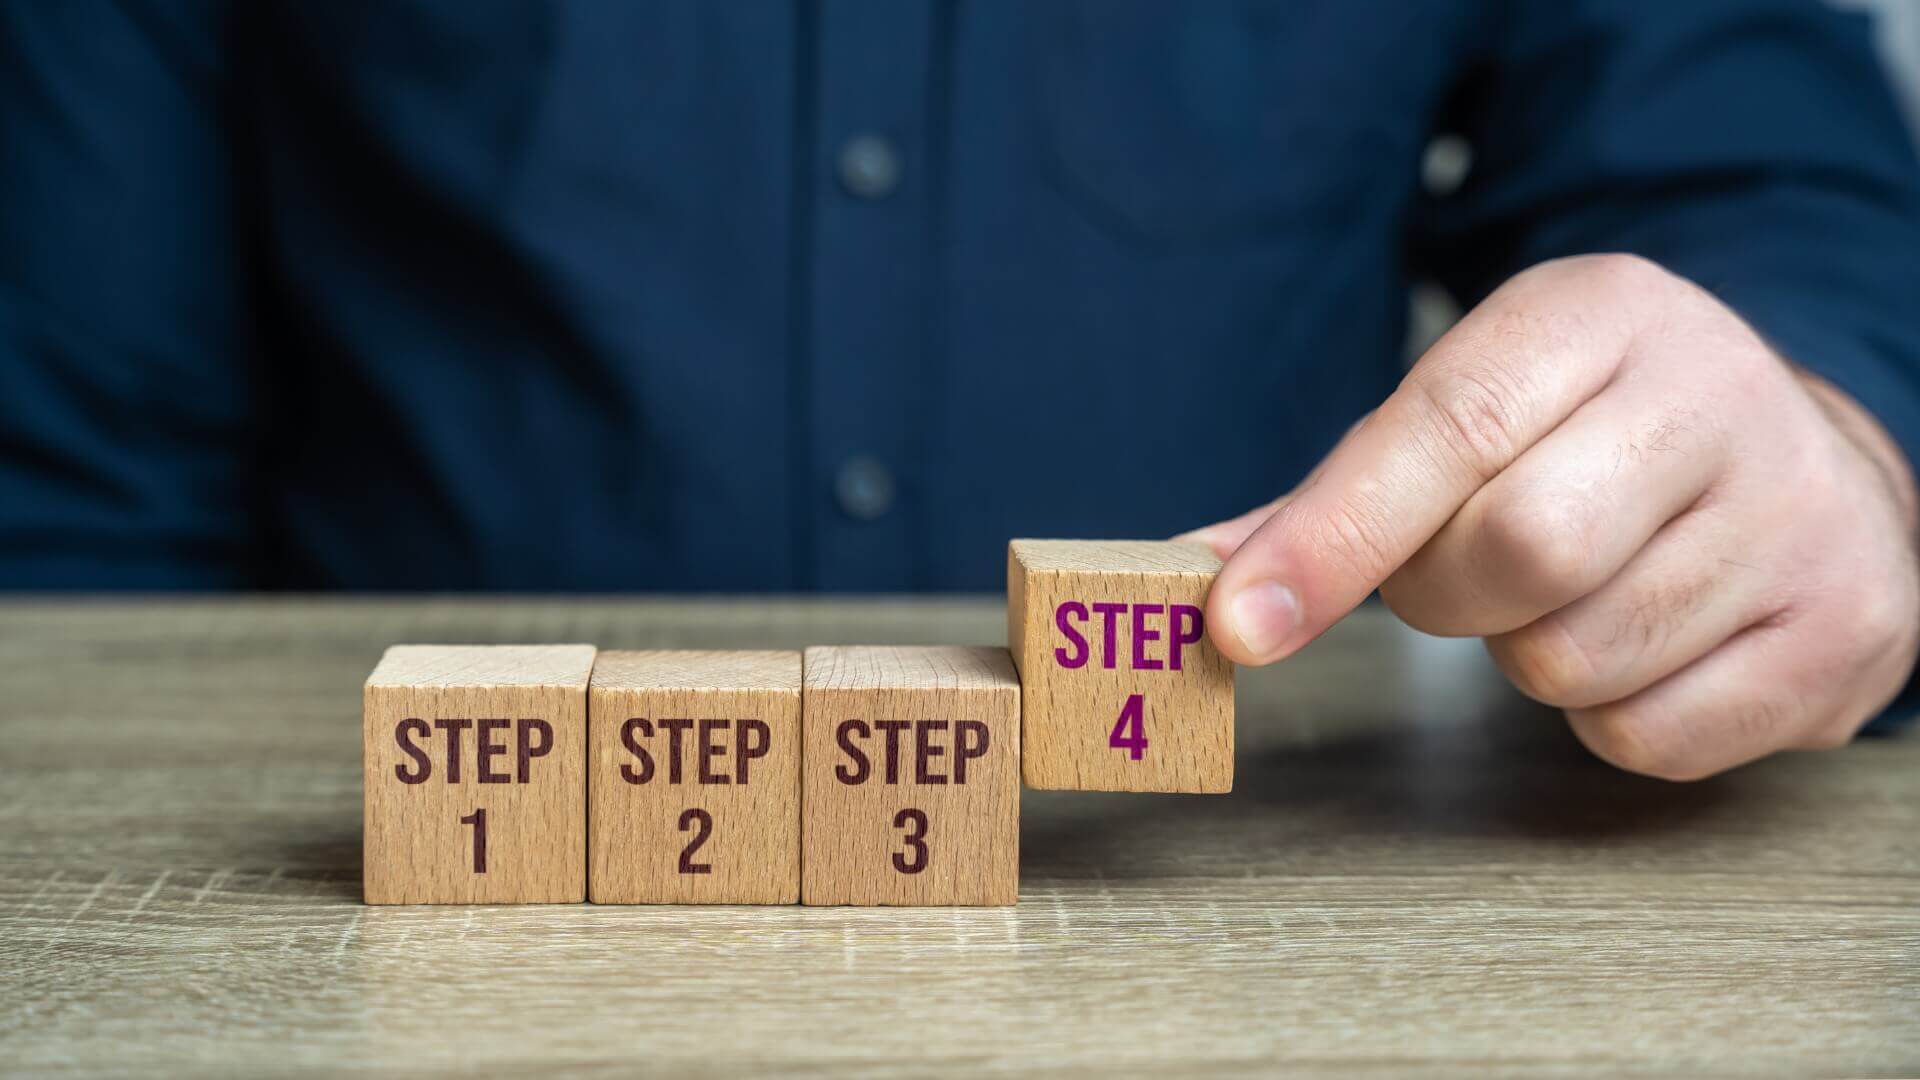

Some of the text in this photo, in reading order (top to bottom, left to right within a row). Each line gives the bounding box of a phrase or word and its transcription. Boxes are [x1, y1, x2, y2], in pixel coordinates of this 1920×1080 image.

[1054, 600, 1204, 671] STEP
[394, 717, 554, 785] STEP
[620, 717, 772, 786] STEP
[835, 719, 990, 786] STEP
[1109, 694, 1149, 761] 4
[460, 808, 487, 874] 1
[678, 807, 713, 875] 2
[891, 807, 929, 875] 3
